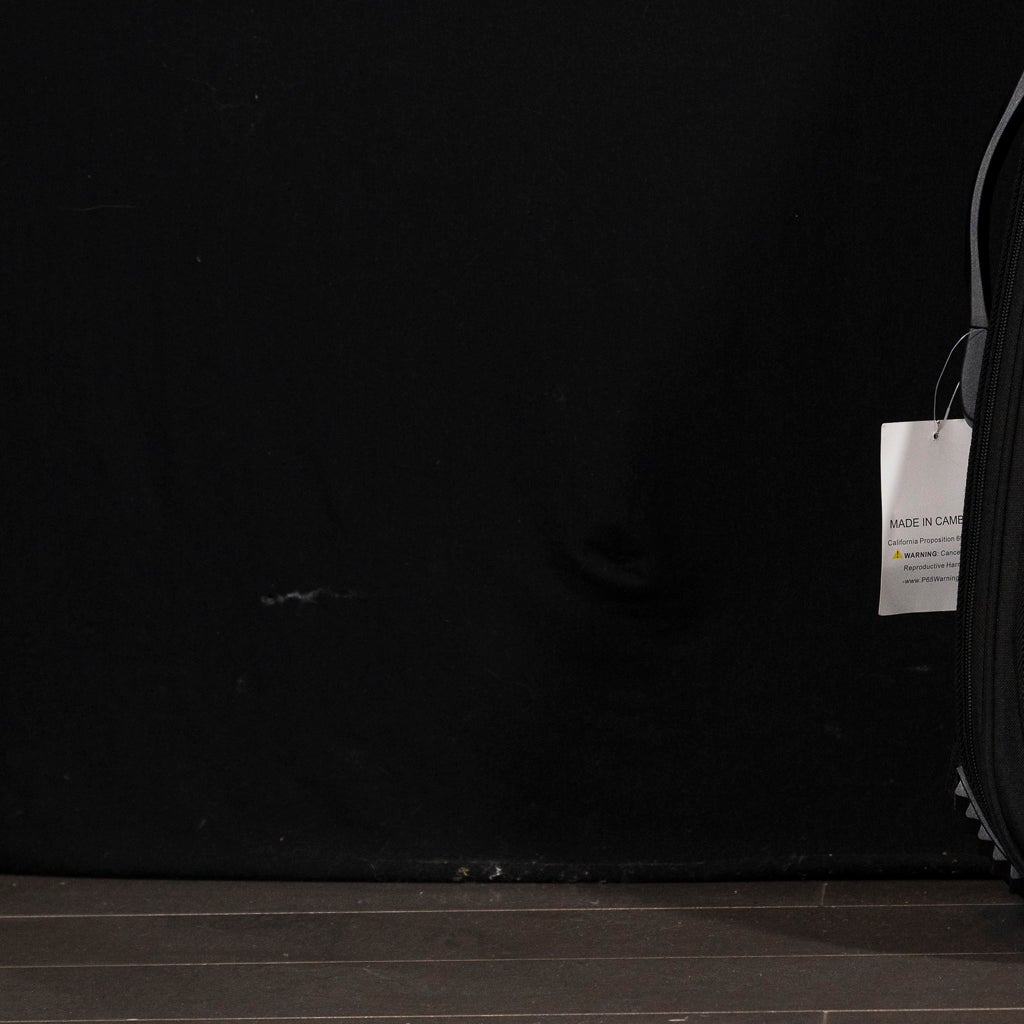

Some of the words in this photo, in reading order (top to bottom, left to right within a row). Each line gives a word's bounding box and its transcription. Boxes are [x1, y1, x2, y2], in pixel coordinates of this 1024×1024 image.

[889, 517, 920, 529] MADE
[922, 517, 933, 527] IN
[887, 538, 918, 546] California
[919, 535, 955, 545] Proposition
[903, 562, 945, 571] Reproductive
